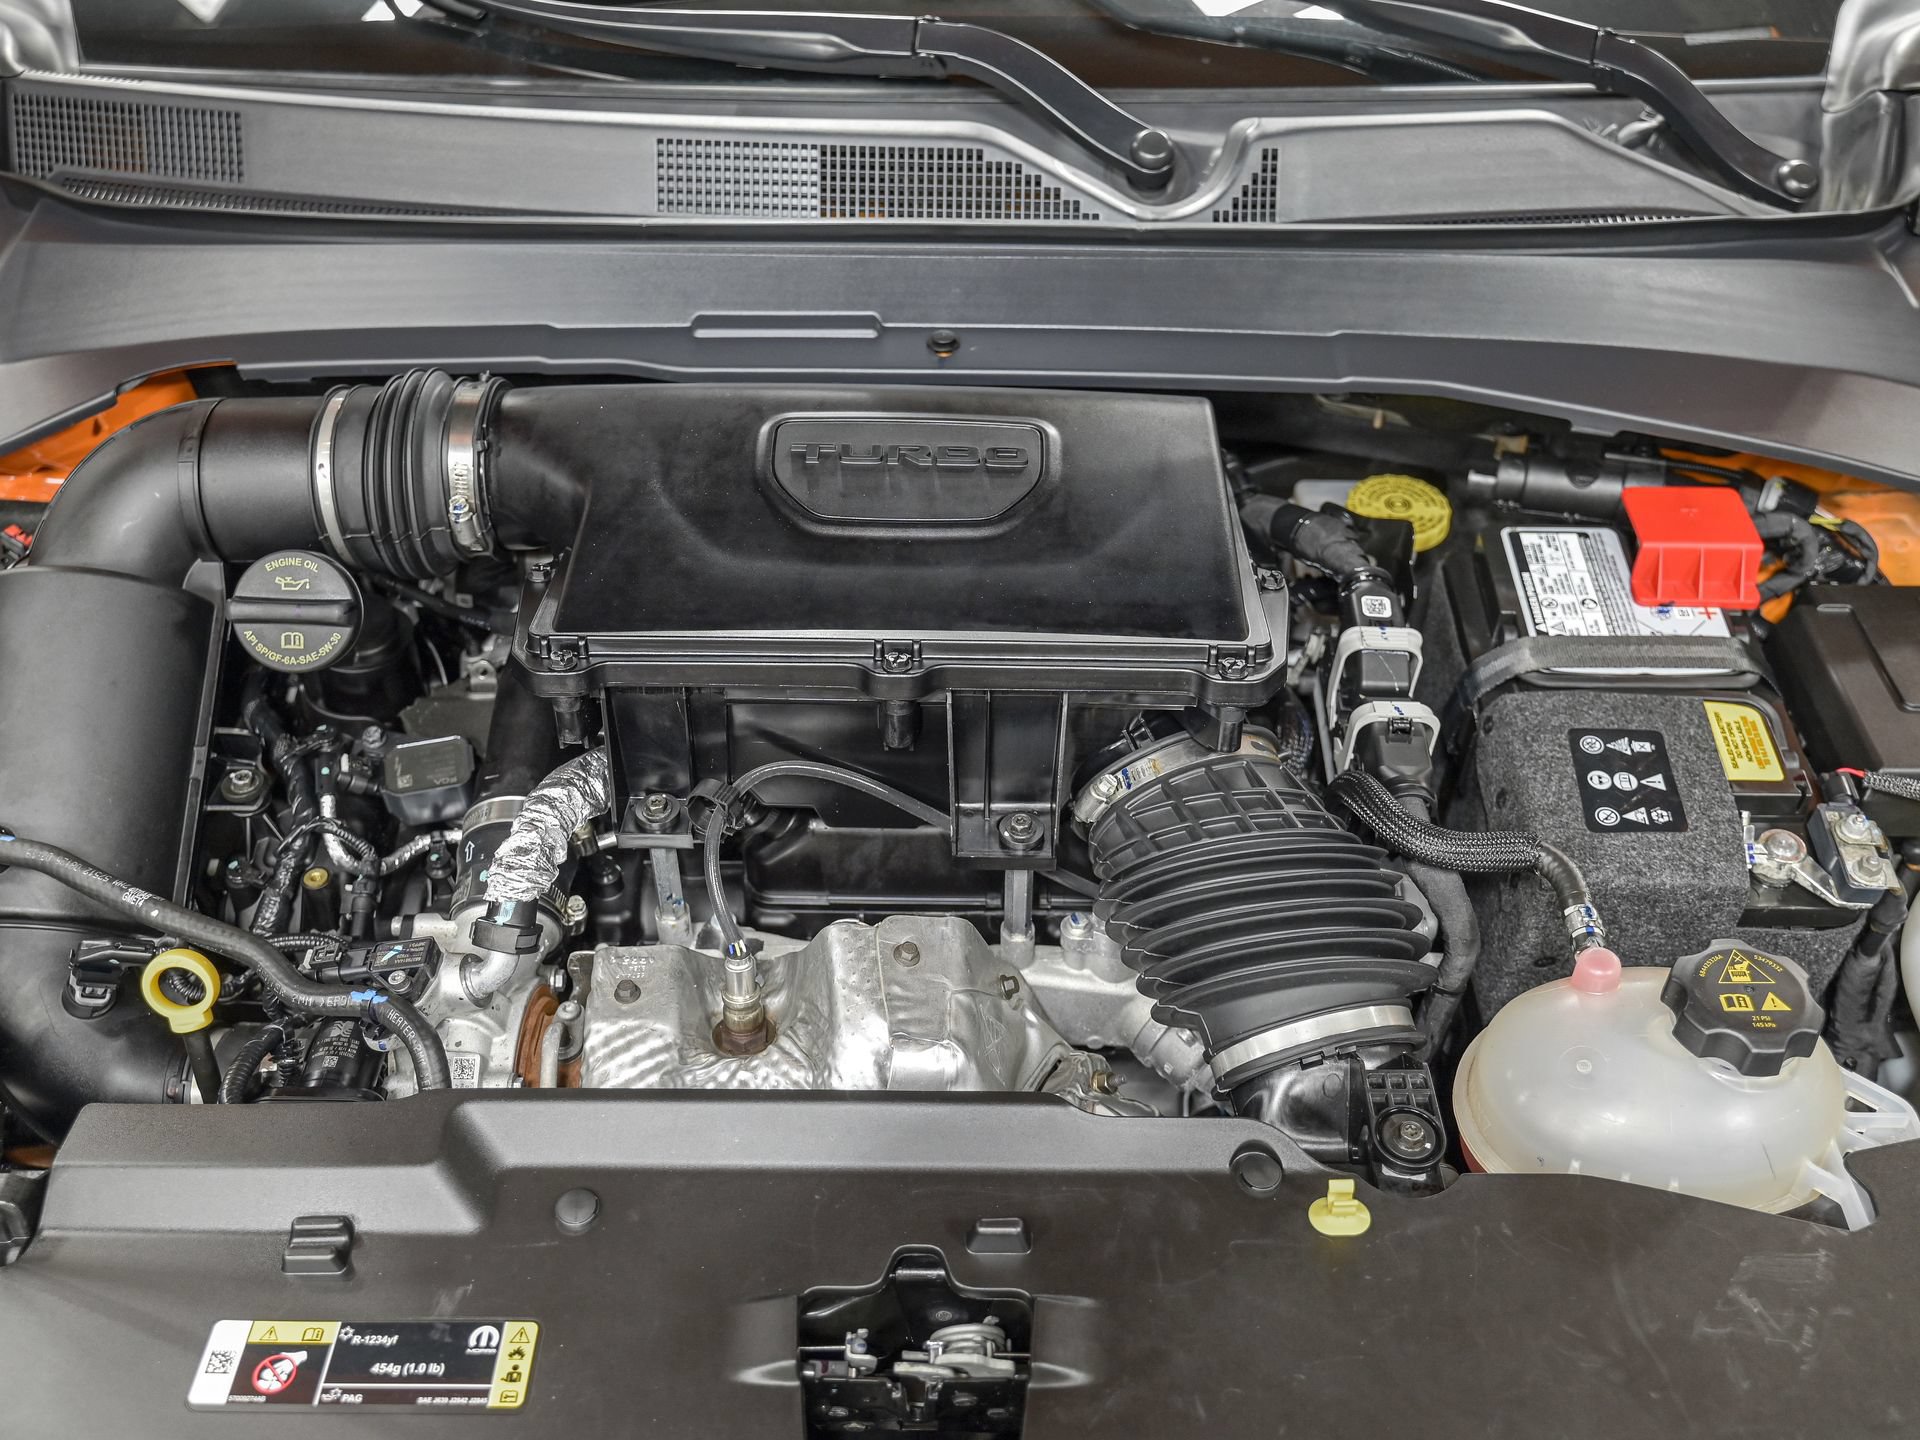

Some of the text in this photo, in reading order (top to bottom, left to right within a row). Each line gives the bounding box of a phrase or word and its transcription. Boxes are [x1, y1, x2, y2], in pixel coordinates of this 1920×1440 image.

[790, 443, 1029, 467] TURBO
[265, 557, 320, 573] ENGINE OIL
[243, 630, 257, 646] API
[387, 1008, 416, 1043] HEATER
[352, 1334, 399, 1347] R-1234yf
[370, 1363, 446, 1377] 454g (1.0 lb)
[341, 1393, 364, 1404] PAG
